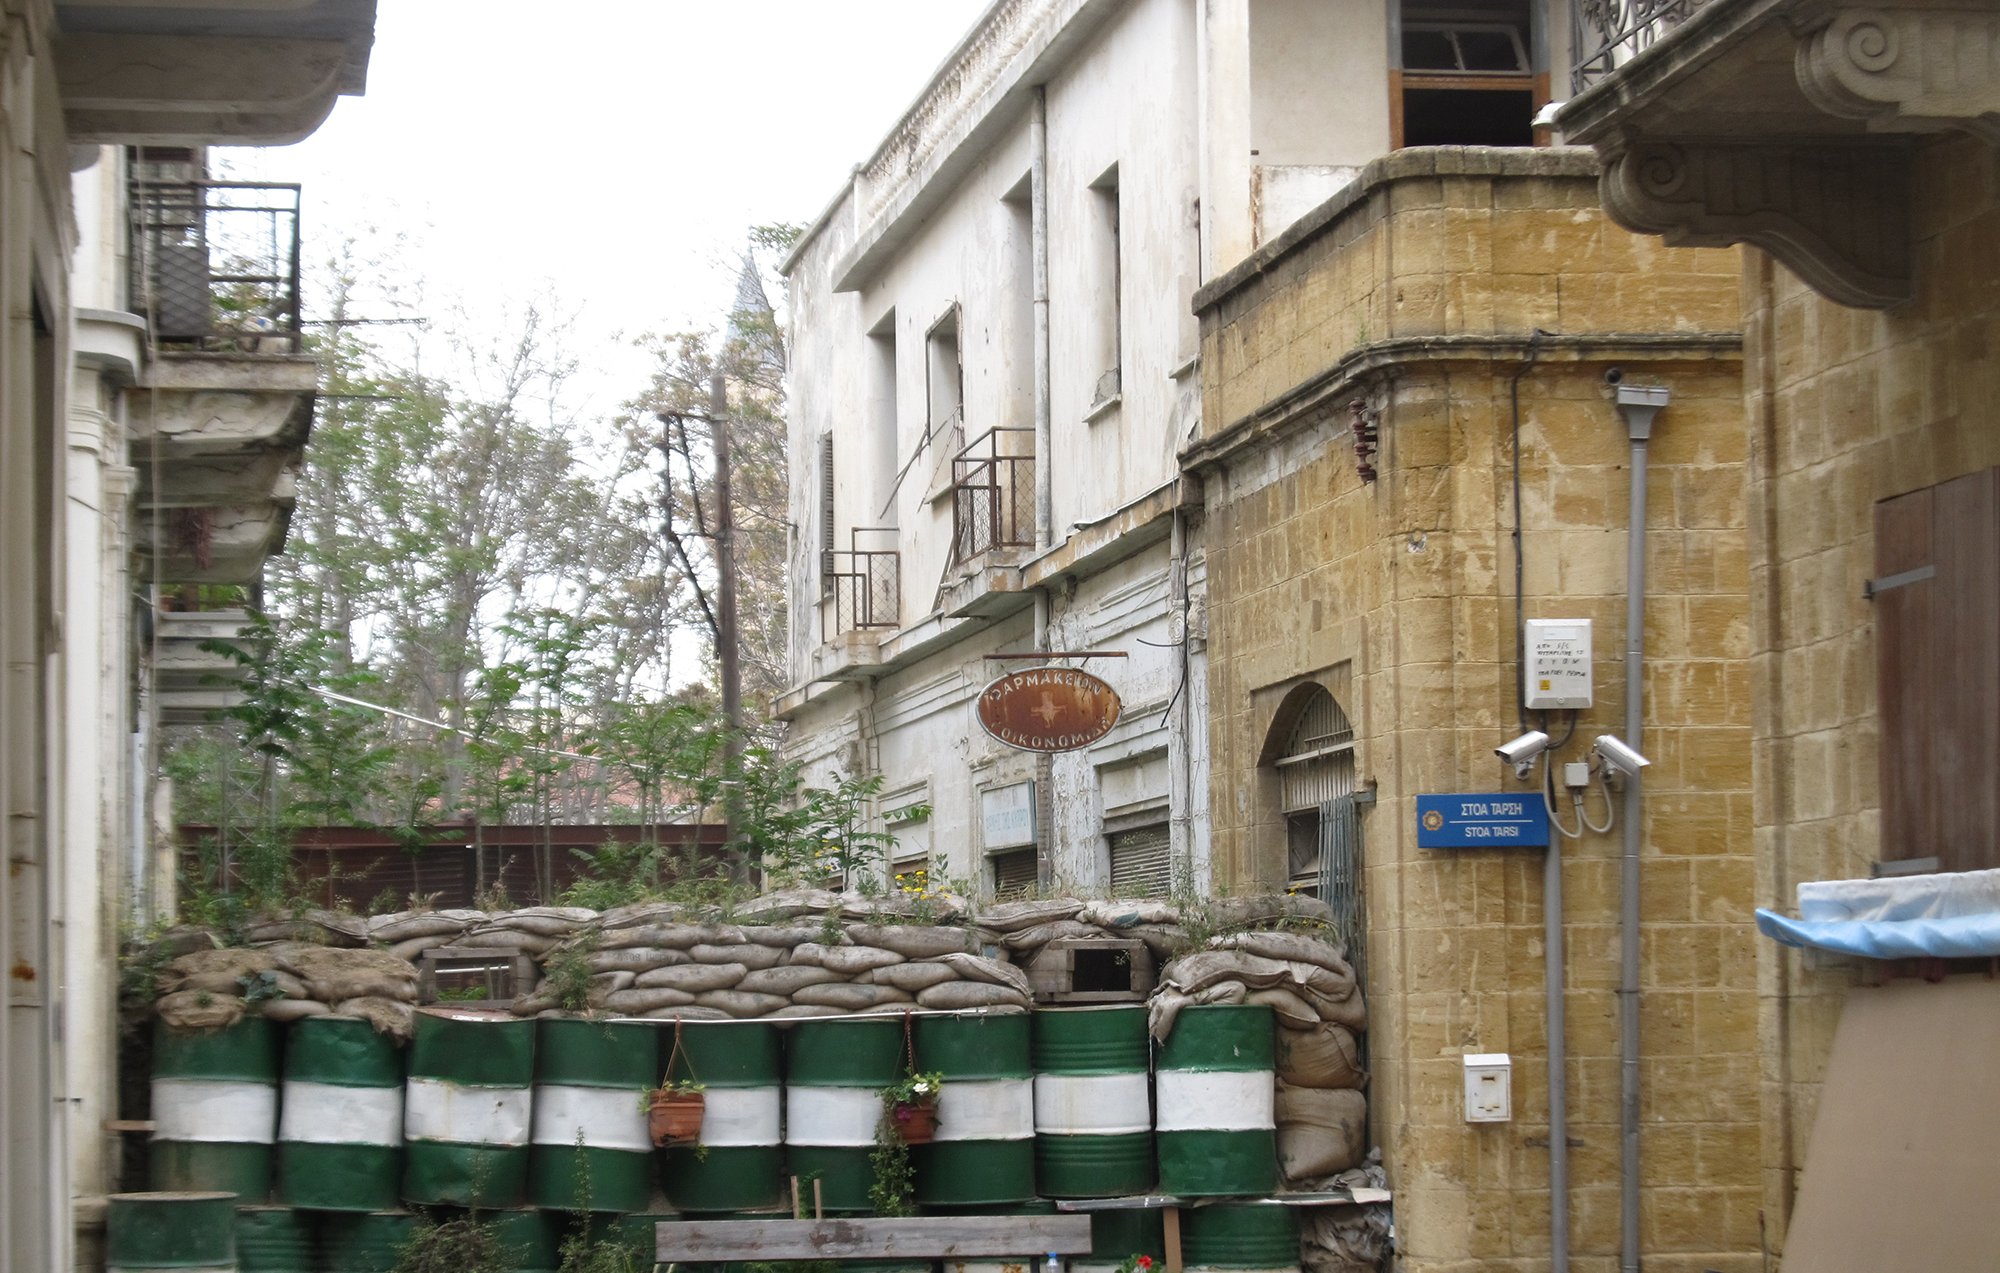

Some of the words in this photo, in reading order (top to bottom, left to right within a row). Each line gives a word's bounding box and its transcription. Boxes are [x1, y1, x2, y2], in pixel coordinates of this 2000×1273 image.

[1461, 803, 1489, 816] ΣΤΟΑ
[1491, 802, 1522, 815] ΤΑΡΣΗ
[1465, 827, 1490, 838] STOA
[1492, 826, 1518, 837] TARSI
